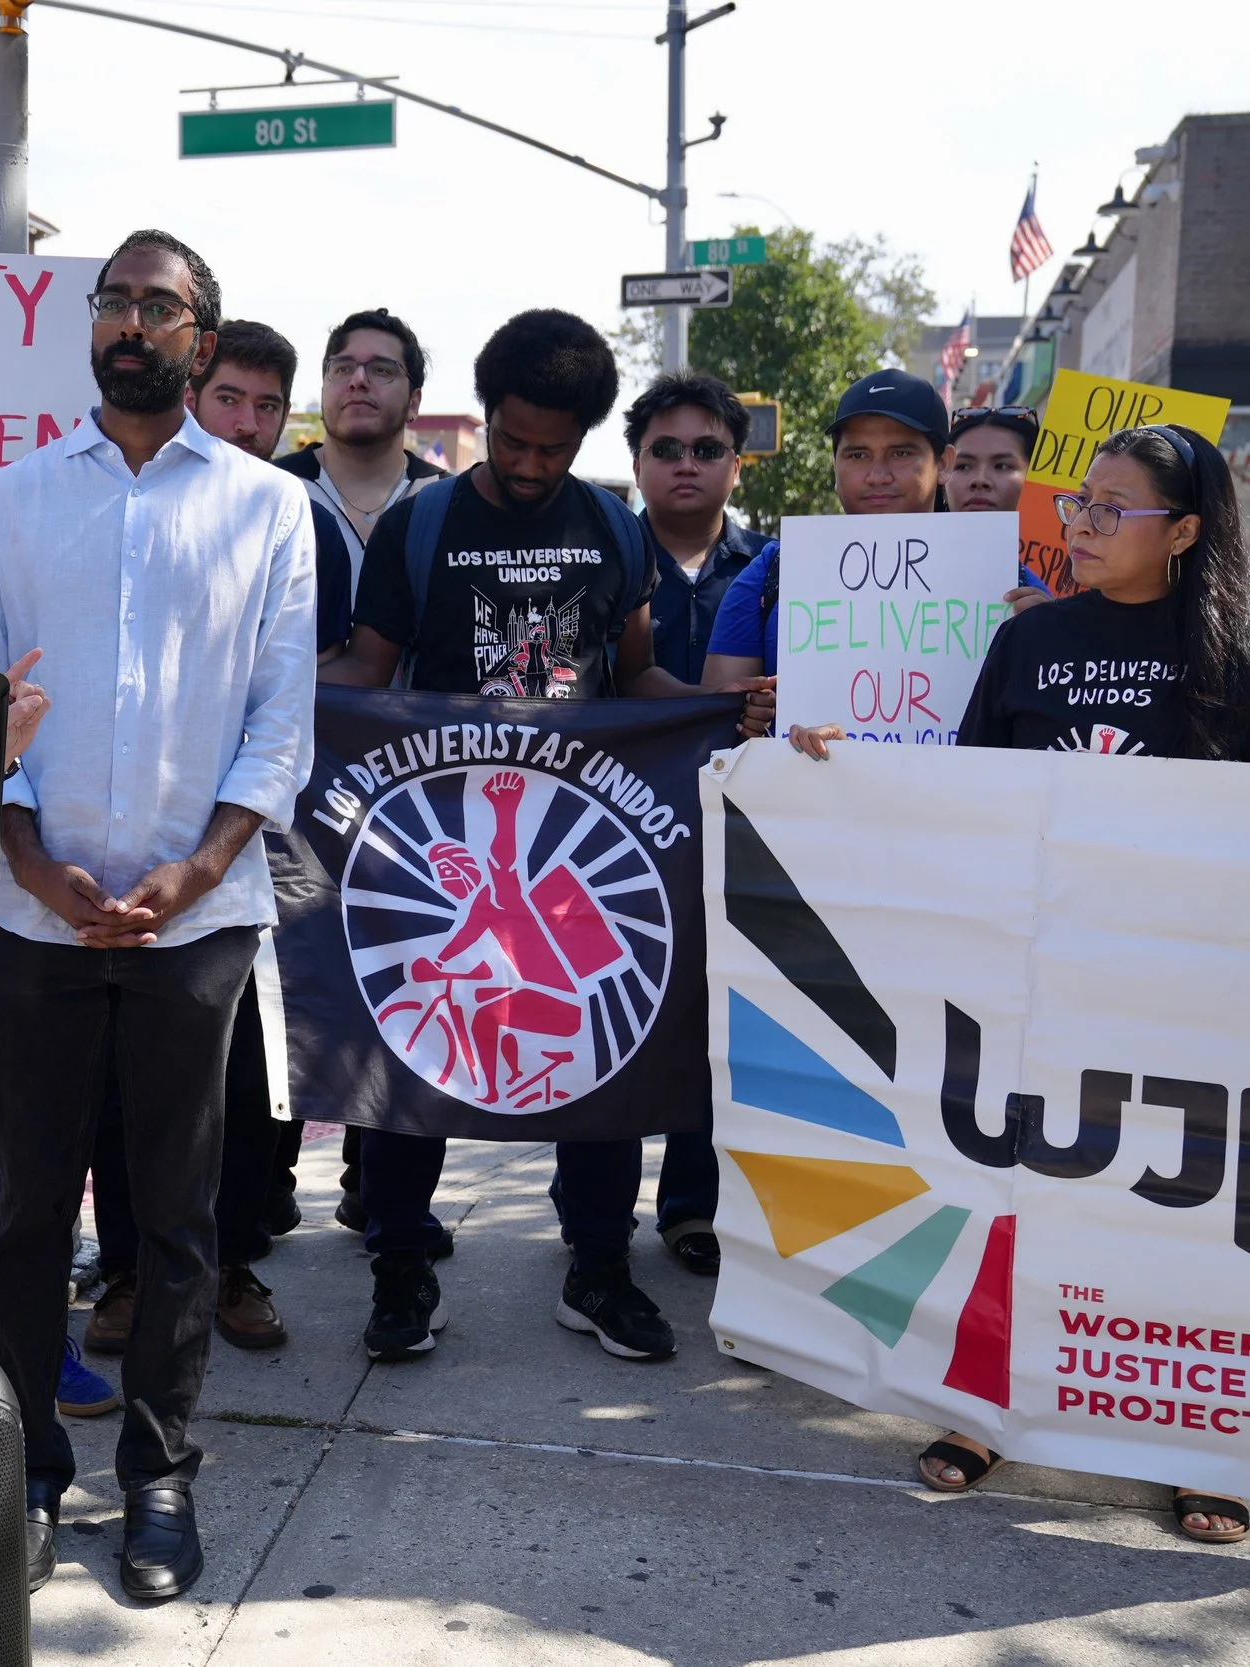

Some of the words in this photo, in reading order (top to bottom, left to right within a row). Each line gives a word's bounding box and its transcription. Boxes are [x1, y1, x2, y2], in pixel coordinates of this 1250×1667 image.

[255, 119, 285, 146] 80
[293, 117, 317, 144] St
[707, 241, 730, 263] 80
[630, 283, 661, 297] ONE
[680, 280, 714, 295] WAY
[1084, 386, 1163, 434] OUR
[448, 551, 482, 567] LOS
[485, 548, 602, 565] DELIVERISTAS
[839, 538, 931, 592] OUR
[498, 566, 562, 583] UNIDOS
[474, 596, 492, 627] WE
[474, 625, 499, 644] HAVE
[474, 643, 508, 681] POWER
[1038, 662, 1074, 690] LOS
[851, 668, 941, 724] OUR
[1067, 687, 1152, 707] UNIDOS
[312, 778, 362, 835] LOS
[346, 723, 584, 795] DELIVERISTAS
[579, 750, 691, 850] UNIDOS
[940, 998, 1250, 1254] WJ
[1058, 1283, 1104, 1303] THE
[1055, 1346, 1246, 1398] JUSTICE
